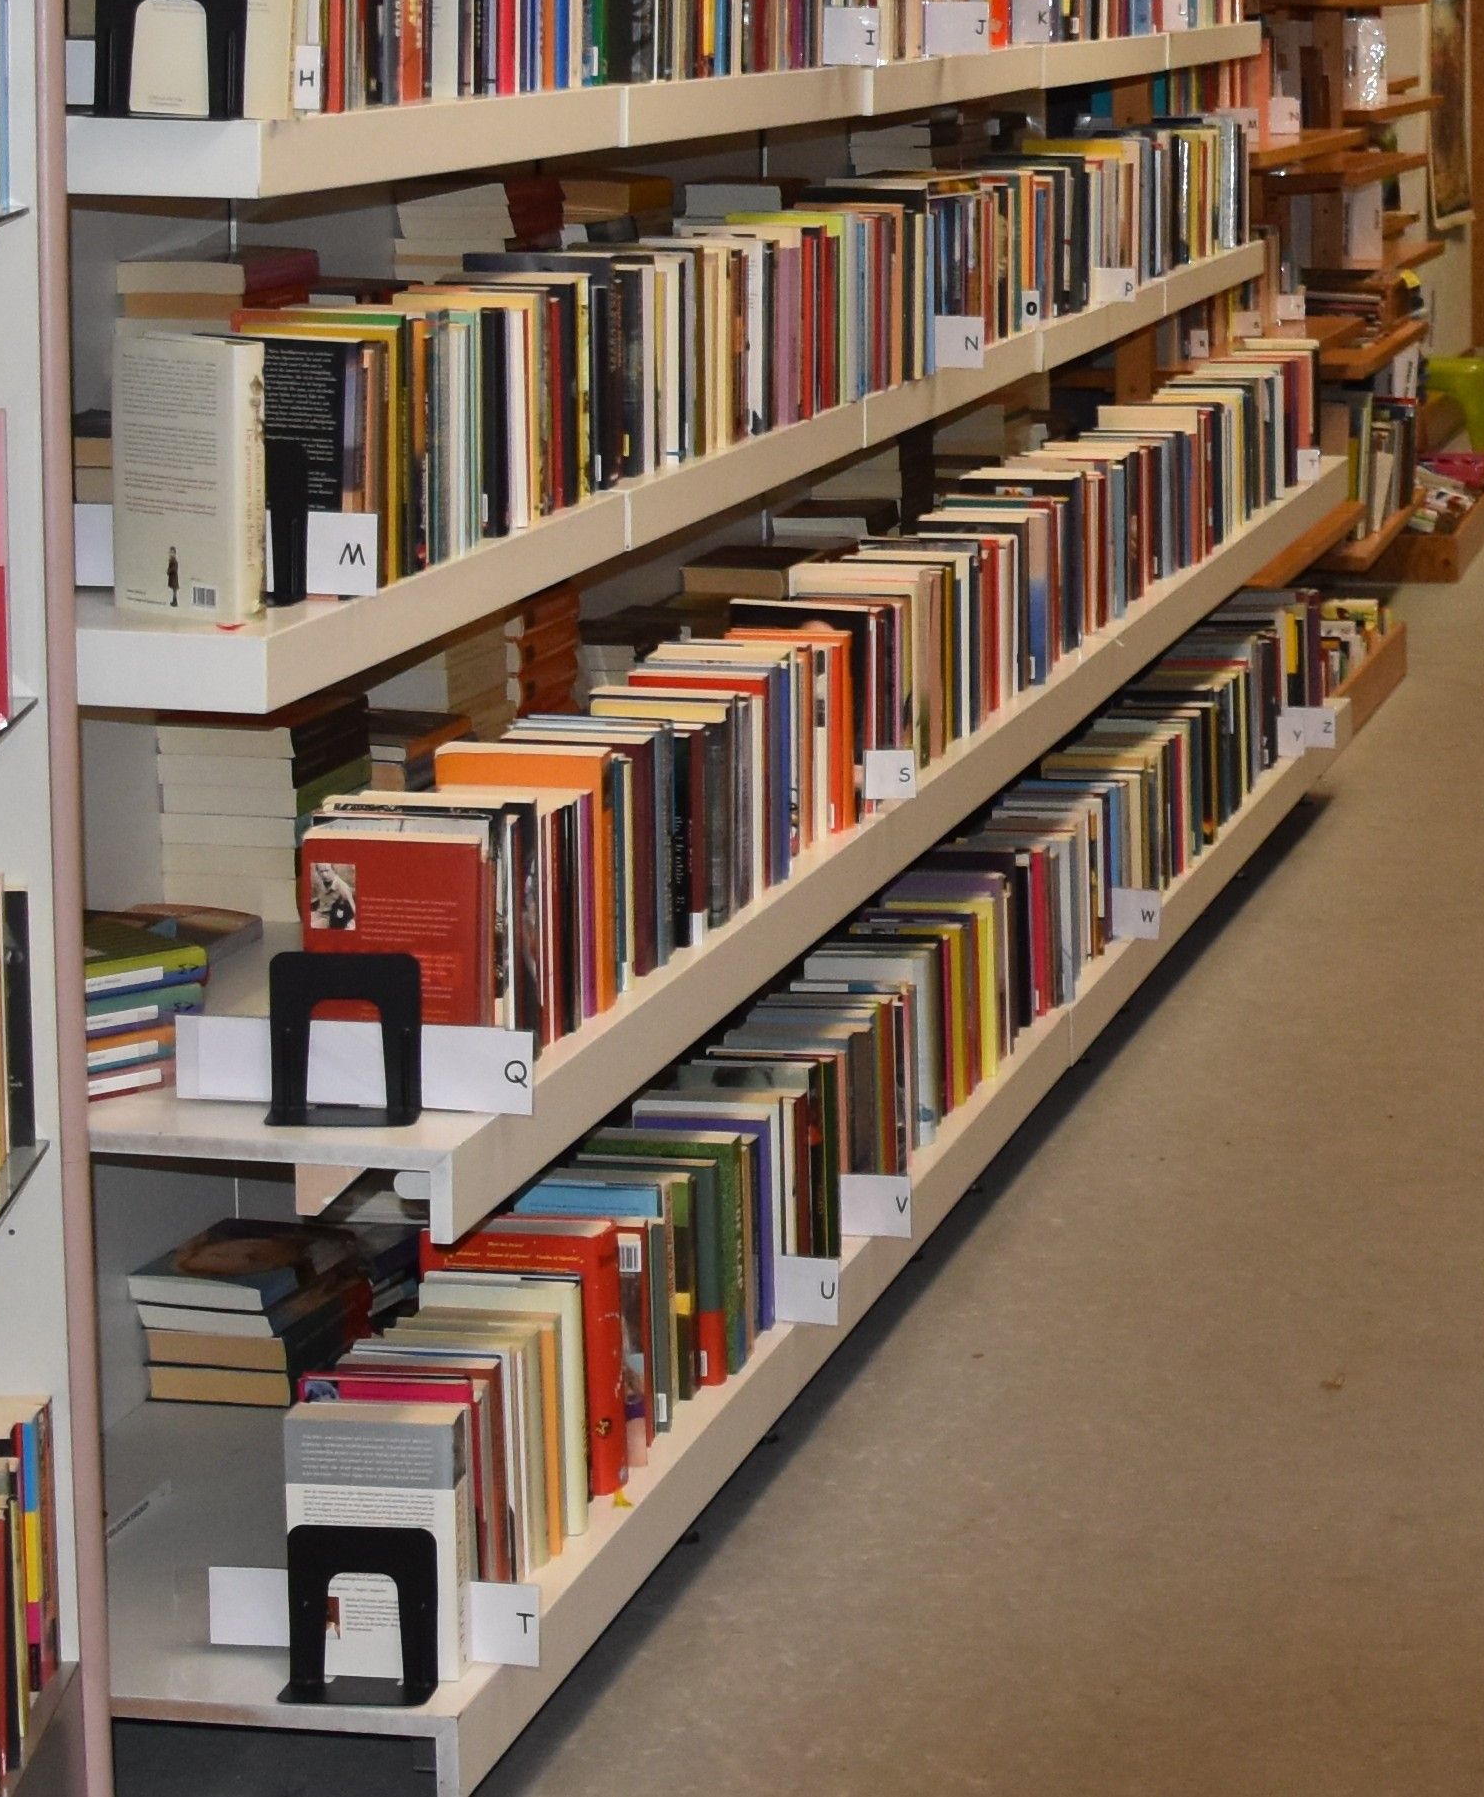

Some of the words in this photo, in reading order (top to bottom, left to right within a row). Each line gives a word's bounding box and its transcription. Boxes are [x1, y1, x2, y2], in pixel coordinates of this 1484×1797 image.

[864, 28, 876, 47] I
[975, 18, 986, 37] J
[298, 68, 315, 89] H
[1025, 301, 1038, 316] O
[964, 334, 979, 351] N
[338, 542, 366, 567] M
[898, 766, 911, 784] S
[1140, 908, 1155, 924] W
[503, 1059, 529, 1090] Q
[895, 1194, 908, 1216] V
[820, 1280, 836, 1302] U
[515, 1611, 536, 1636] T
